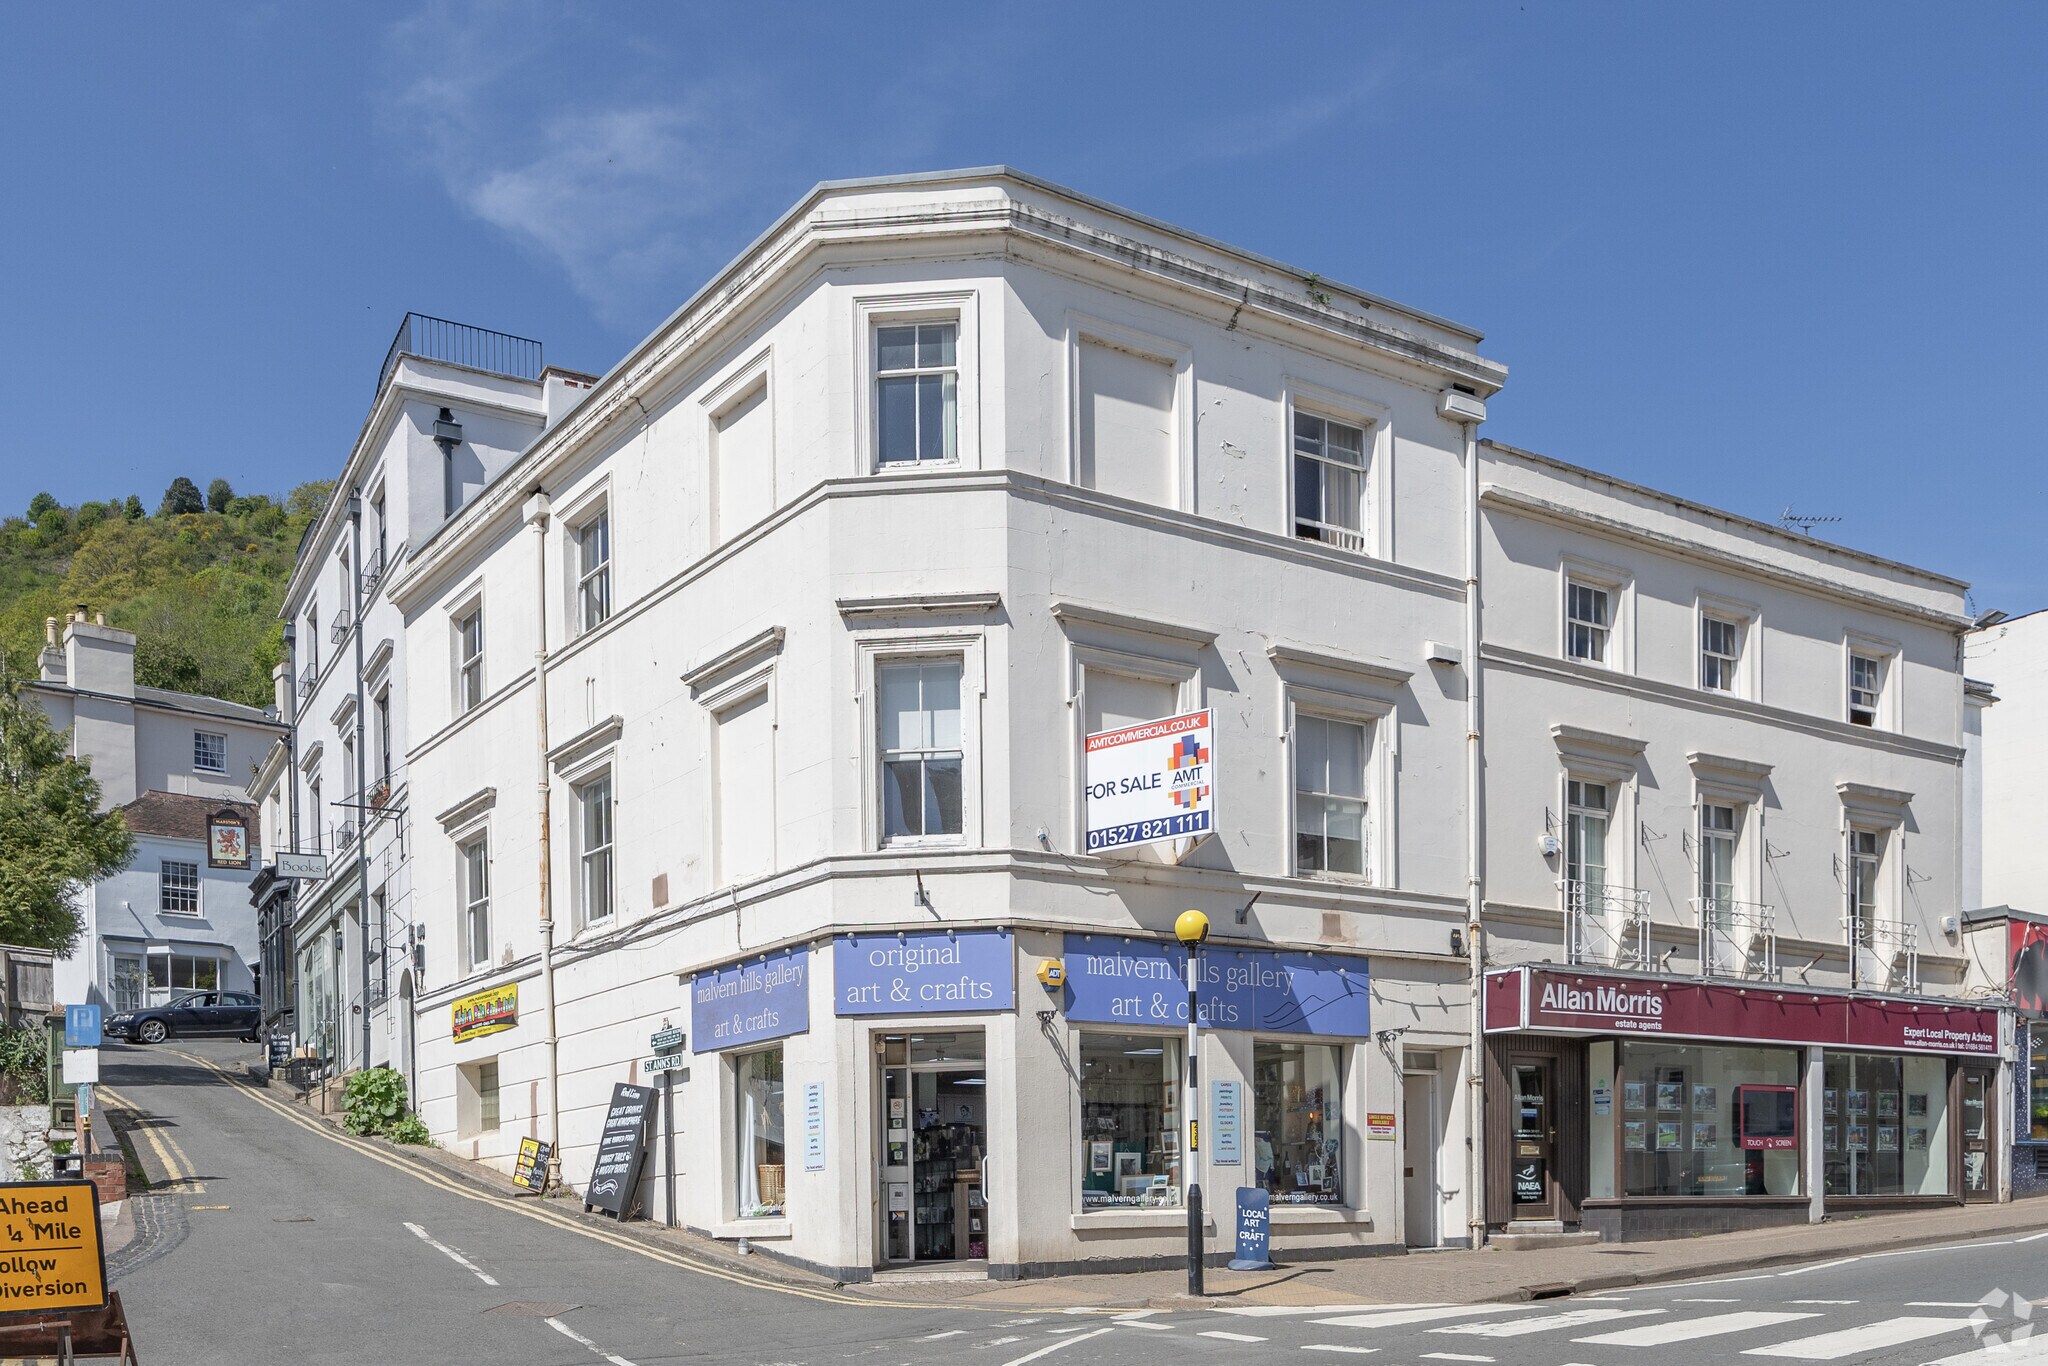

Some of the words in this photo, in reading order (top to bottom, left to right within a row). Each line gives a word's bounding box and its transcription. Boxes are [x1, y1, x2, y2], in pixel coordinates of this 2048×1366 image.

[1088, 717, 1201, 750] AMTCOMMERCIAL.CO.UK
[1172, 766, 1203, 785] AMT
[1086, 781, 1116, 801] FOR
[1120, 772, 1162, 794] SALE
[1171, 780, 1205, 790] COMMERCIAL
[1089, 824, 1138, 848] 01527
[1142, 818, 1171, 839] 821
[1176, 812, 1203, 834] 111
[282, 860, 322, 873] Books
[869, 940, 961, 973] original
[1048, 969, 1060, 978] ADT
[1087, 951, 1171, 980] malvern
[1178, 956, 1220, 984] hlls
[1226, 962, 1295, 996] gallery
[697, 982, 738, 1004] malvern
[740, 971, 763, 994] hills
[765, 964, 804, 994] gallery
[847, 982, 882, 1003] art
[890, 978, 912, 1002] &
[920, 976, 993, 1001] crafts
[1111, 996, 1143, 1017] art
[1149, 992, 1169, 1018] &
[1176, 997, 1239, 1022] cafts
[1540, 983, 1594, 1011] Allan
[1597, 986, 1663, 1015] Morris
[714, 1020, 729, 1038] art
[733, 1014, 743, 1034] &
[745, 1008, 779, 1032] crafts
[1615, 1020, 1637, 1029] estate
[1638, 1022, 1662, 1031] agents
[1904, 1026, 1925, 1038] Expert
[1926, 1028, 1943, 1039] Local
[1945, 1030, 1971, 1042] Property
[1971, 1032, 1992, 1042] Advice
[610, 1106, 624, 1117] GREAT
[625, 1104, 643, 1115] DRINKS
[1518, 1182, 1541, 1191] NAEA
[1269, 1192, 1338, 1203] malverngallery.co.uk
[1242, 1209, 1267, 1219] LOCAL
[1243, 1218, 1260, 1227] ART
[35, 1222, 81, 1240] Mile
[1239, 1231, 1265, 1241] CRAFT
[0, 1256, 56, 1273] ollow
[0, 1280, 87, 1298] iversion
